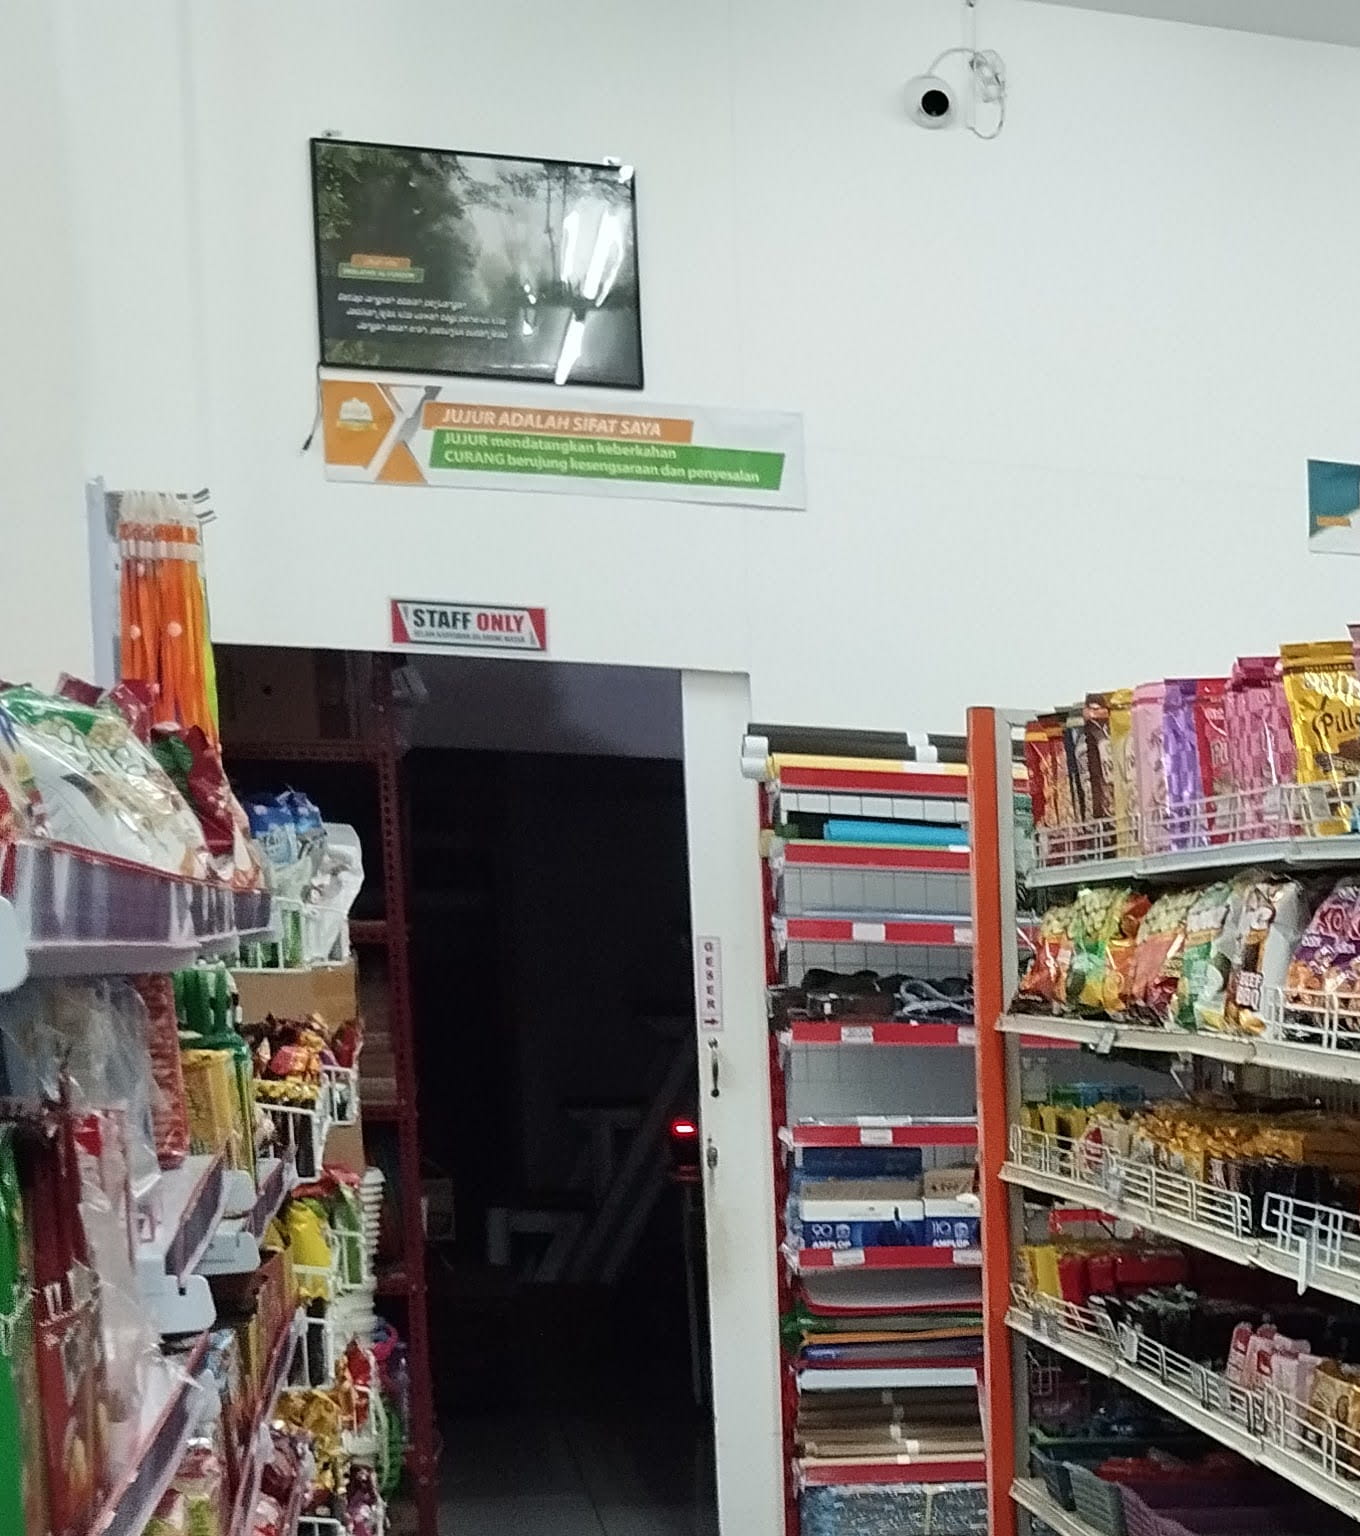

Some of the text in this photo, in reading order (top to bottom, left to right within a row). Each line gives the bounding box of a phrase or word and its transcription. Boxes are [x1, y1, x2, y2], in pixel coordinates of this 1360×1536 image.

[443, 408, 661, 437] JUJUR ADALAH SIFAT SAYA
[443, 432, 488, 446] JUJUR
[491, 435, 594, 454] mendatangkan
[444, 450, 505, 465] CURANG
[507, 454, 568, 471] berujung
[661, 465, 685, 477] dan
[412, 608, 525, 633] STAFF ONLY
[703, 942, 716, 1010] GESER
